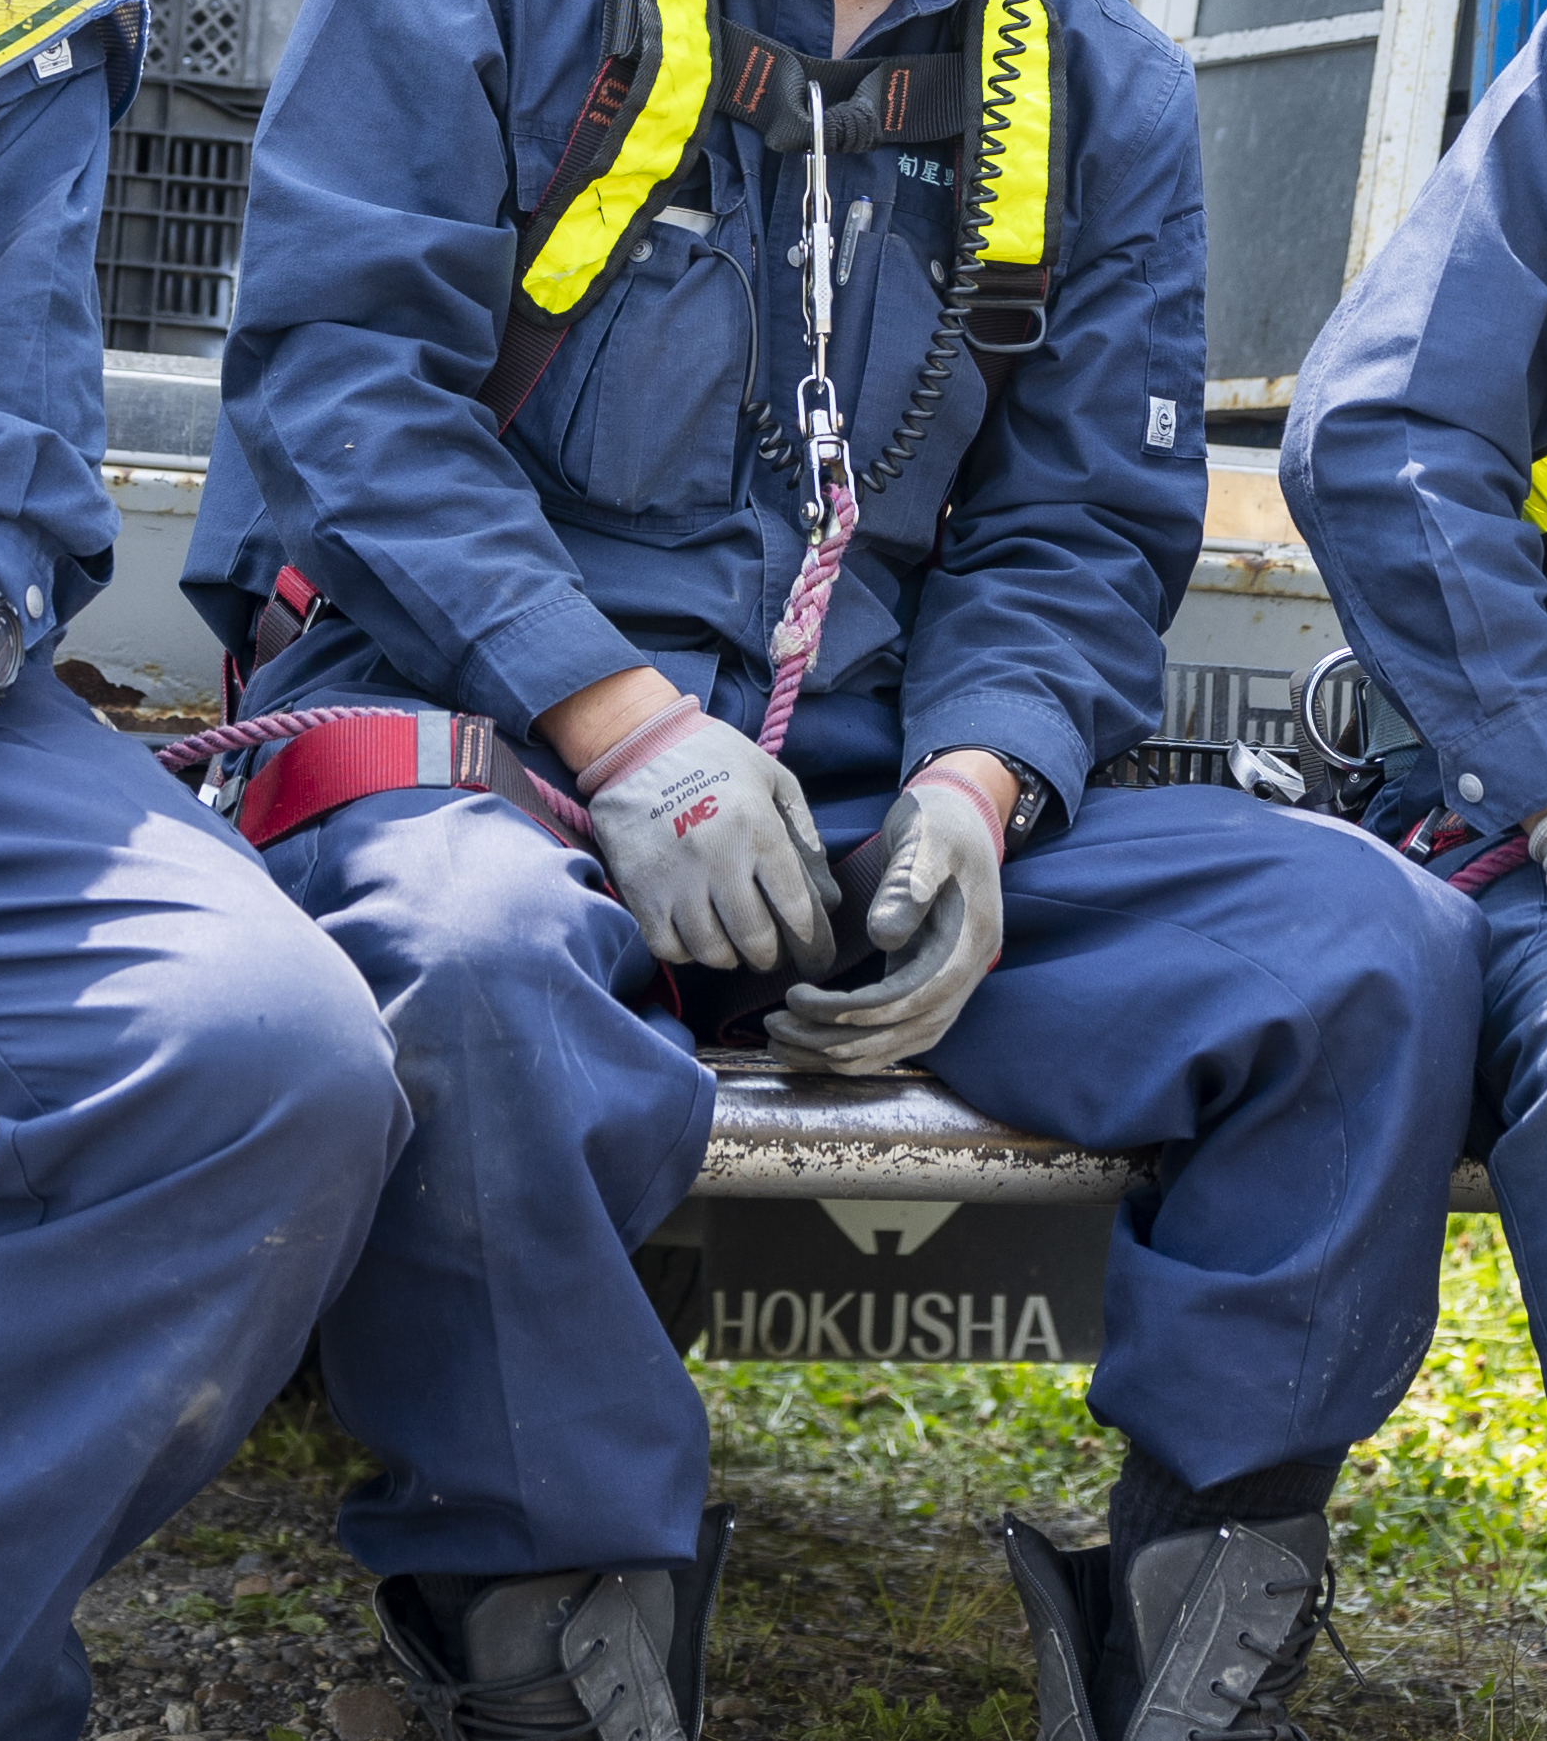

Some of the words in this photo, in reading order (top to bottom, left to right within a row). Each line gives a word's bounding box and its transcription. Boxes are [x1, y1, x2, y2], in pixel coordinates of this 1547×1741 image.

[661, 769, 705, 798] Gloves
[675, 770, 730, 804] Comfort
[650, 800, 675, 819] Grip
[672, 795, 719, 839] 3M
[712, 1289, 1063, 1363] HOKUSHA
